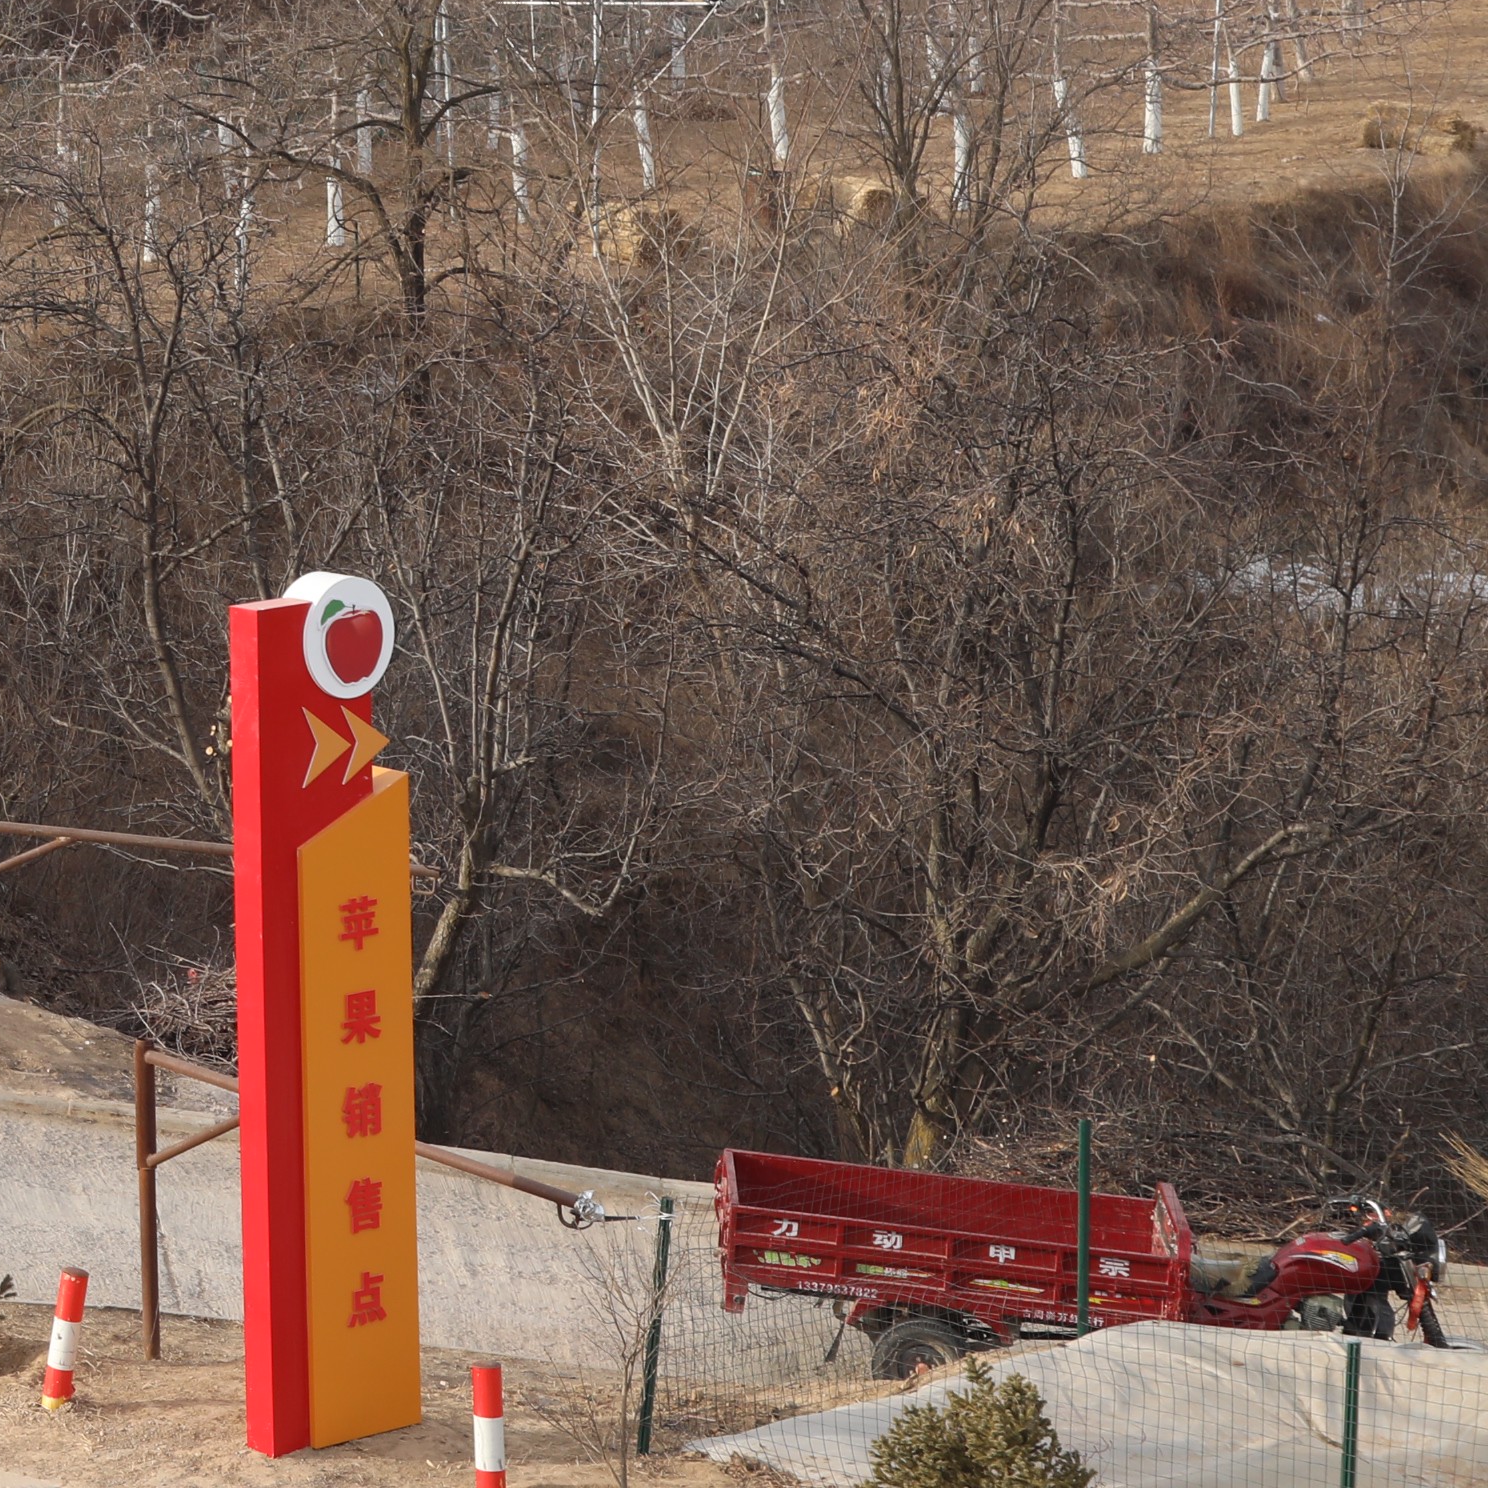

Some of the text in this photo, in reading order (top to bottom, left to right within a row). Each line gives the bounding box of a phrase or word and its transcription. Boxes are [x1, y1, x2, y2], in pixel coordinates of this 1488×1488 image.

[338, 895, 388, 1329] 苹果销售点
